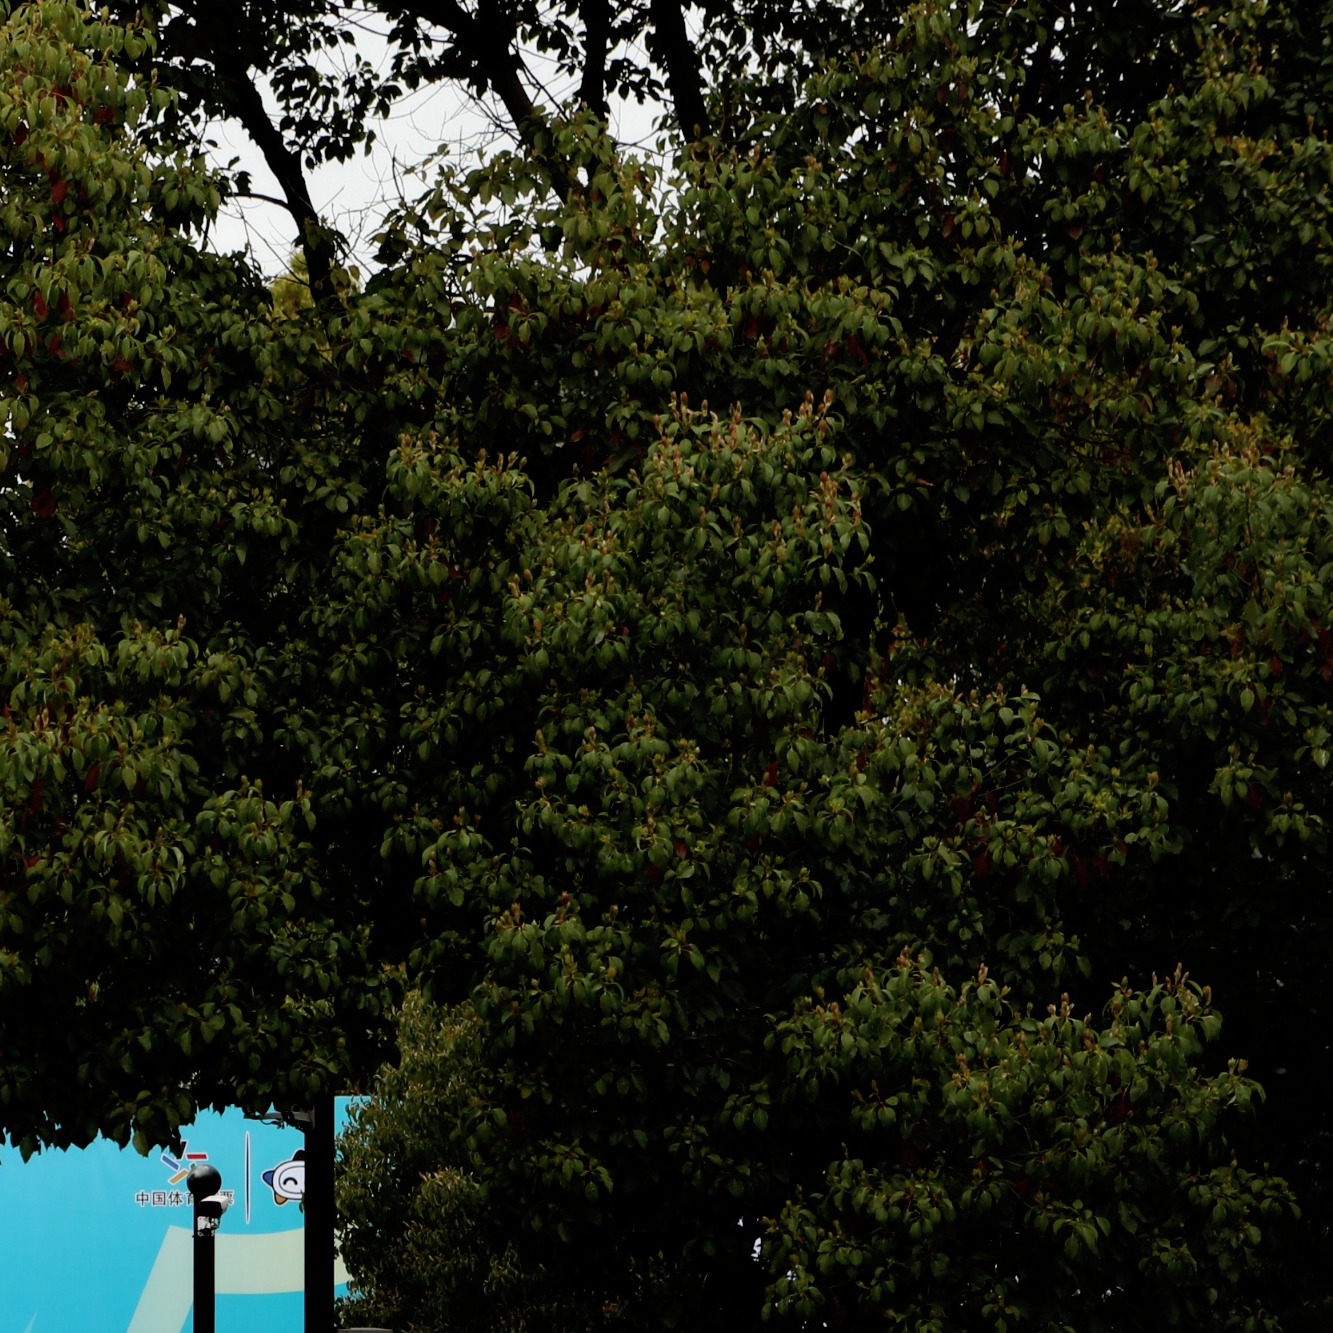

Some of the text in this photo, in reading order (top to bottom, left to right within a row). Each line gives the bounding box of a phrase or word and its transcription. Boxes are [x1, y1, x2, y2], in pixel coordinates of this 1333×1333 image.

[136, 1190, 234, 1207] 中国体育票
